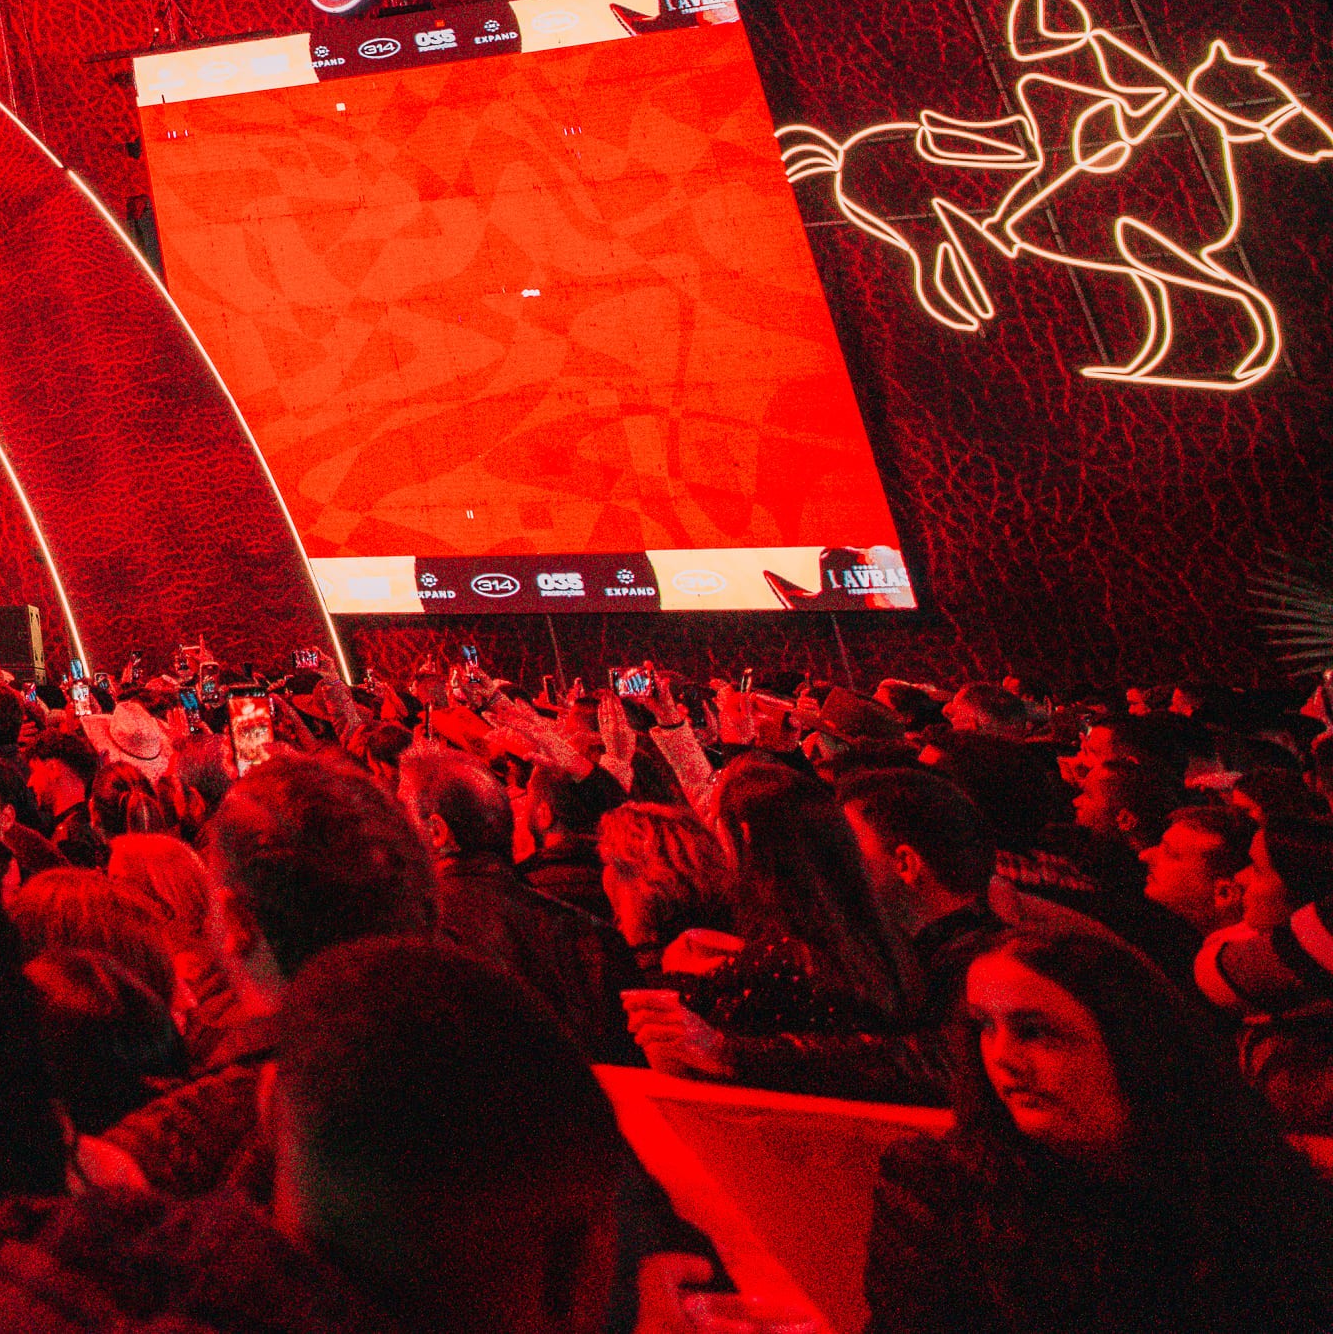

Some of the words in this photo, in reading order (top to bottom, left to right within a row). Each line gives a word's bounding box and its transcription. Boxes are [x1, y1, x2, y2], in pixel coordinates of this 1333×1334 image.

[474, 31, 518, 45] EXPAND
[362, 43, 395, 56] 314
[477, 580, 514, 591] 314
[604, 587, 656, 597] EXPAND
